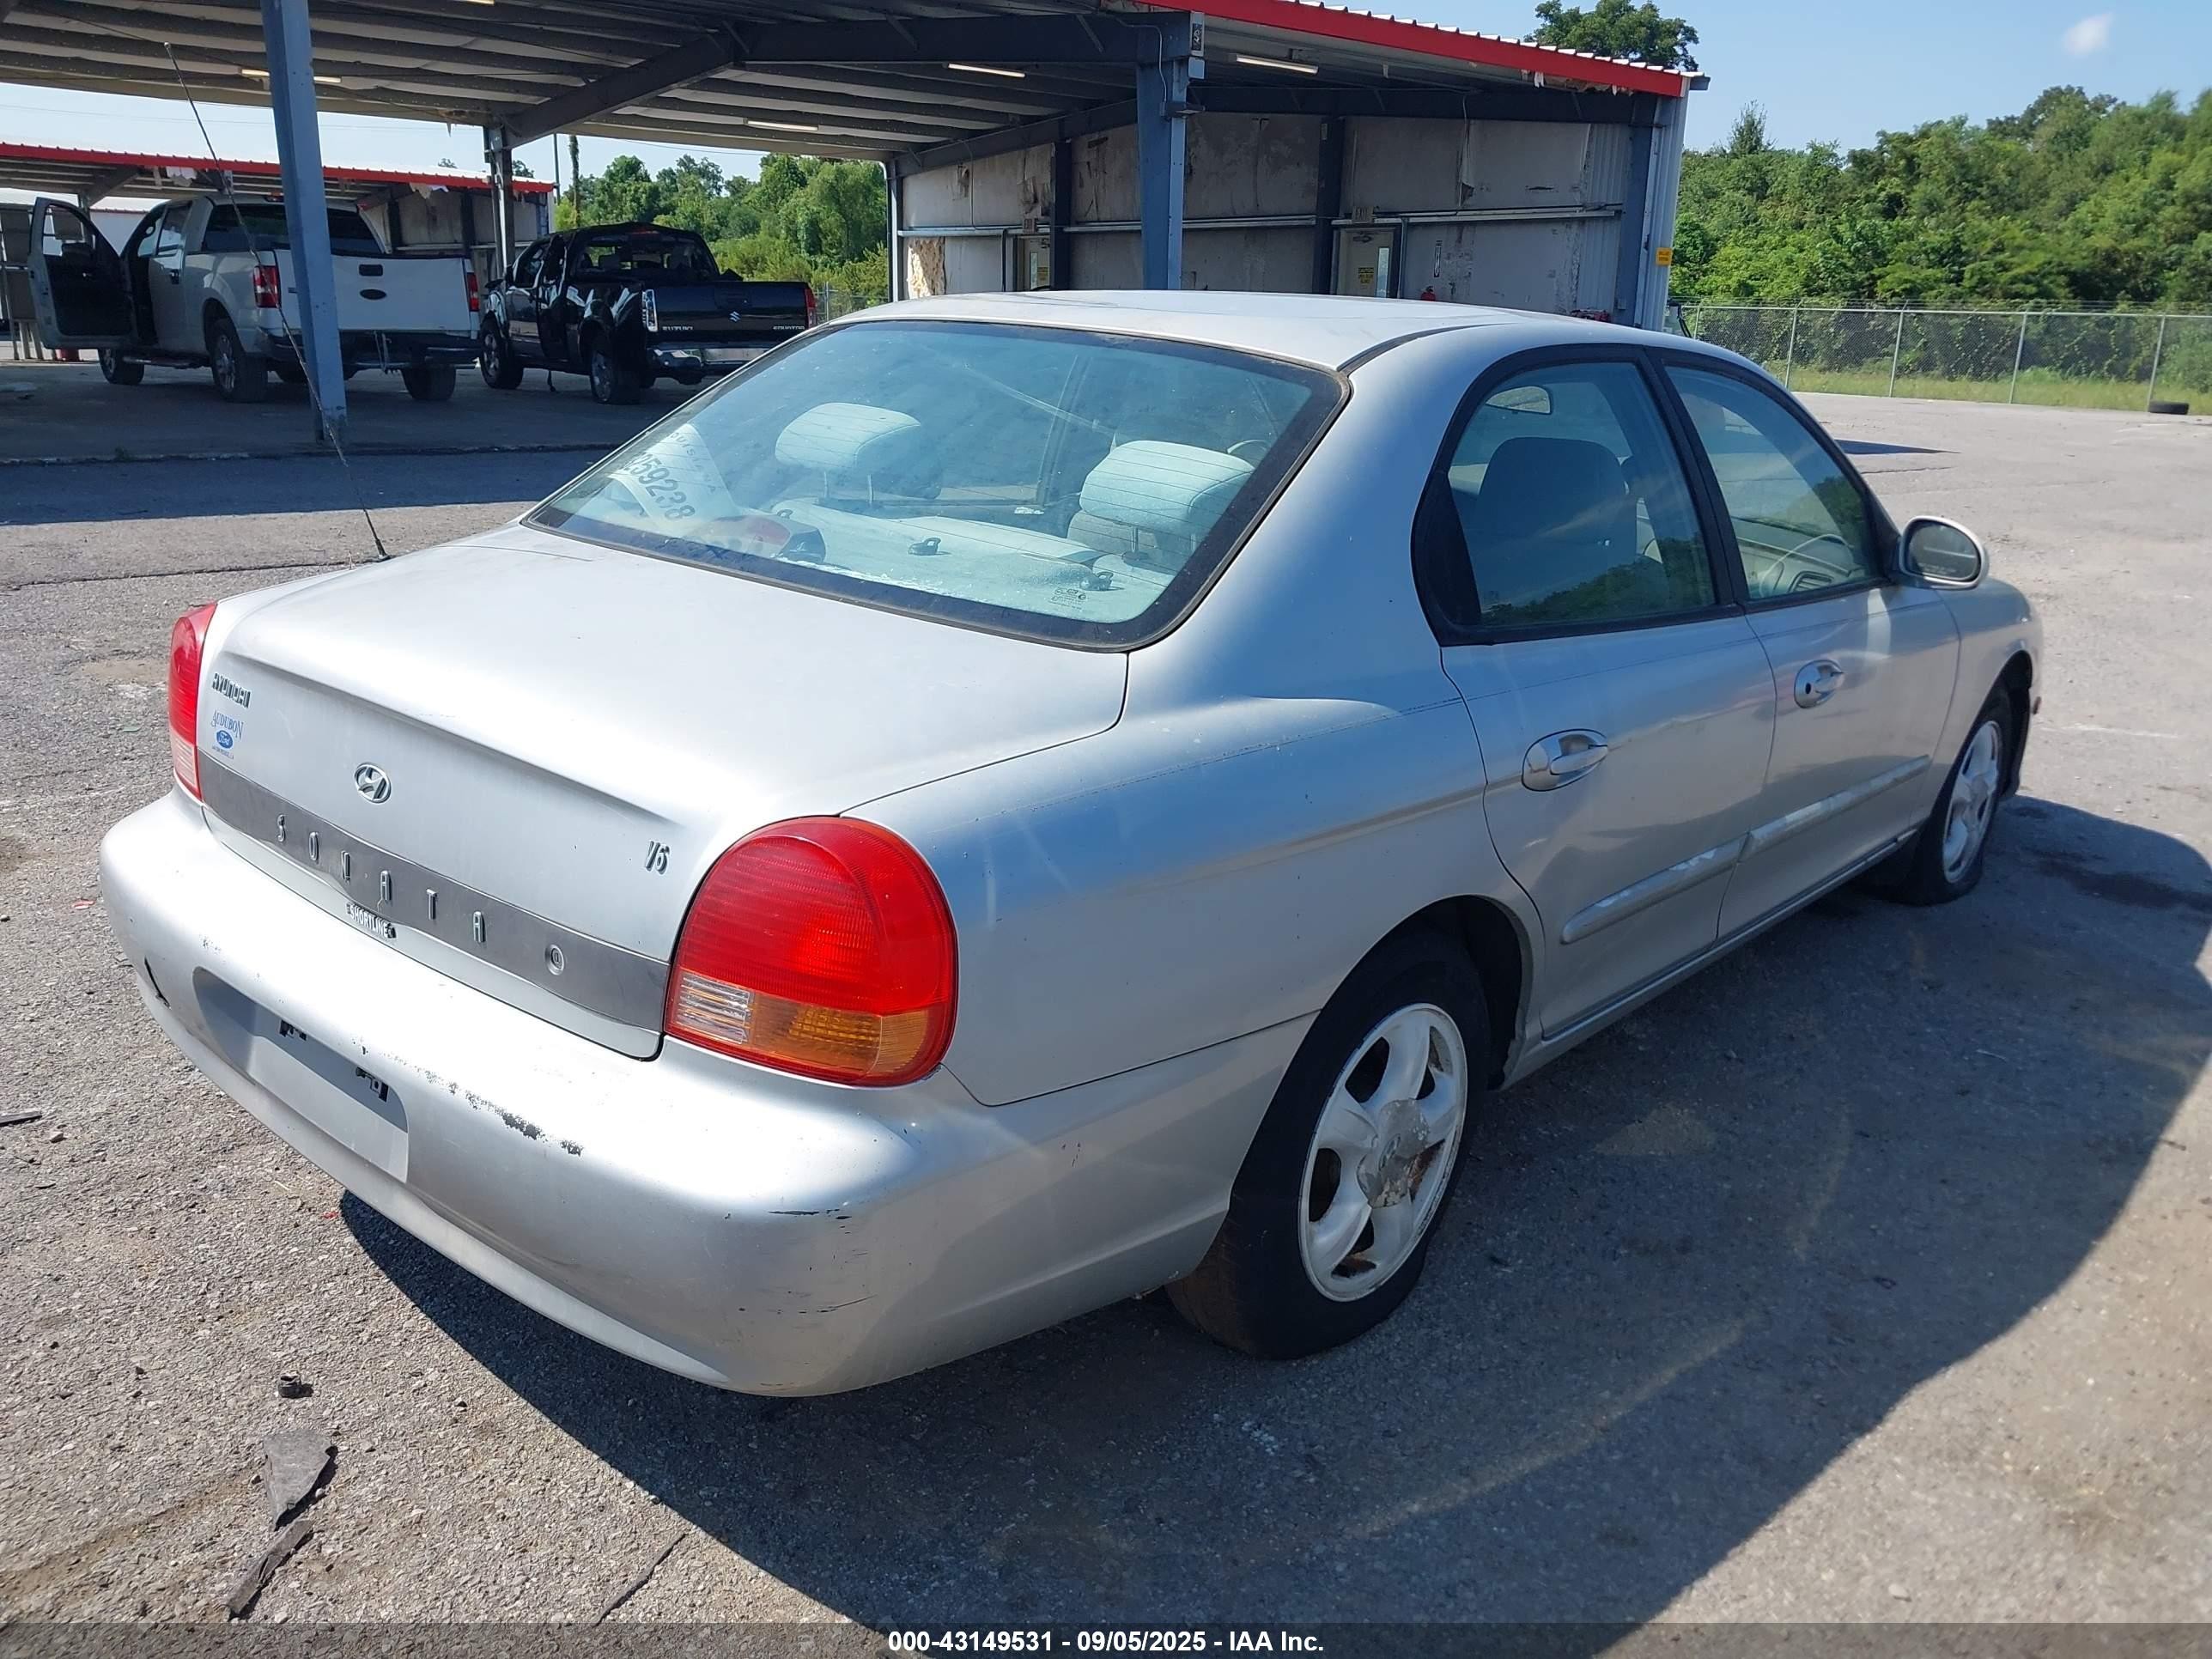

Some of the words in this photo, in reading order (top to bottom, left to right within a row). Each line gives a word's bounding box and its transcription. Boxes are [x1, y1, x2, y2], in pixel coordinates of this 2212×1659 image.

[210, 708, 244, 740] AUDUBON
[646, 840, 670, 875] V6
[276, 814, 487, 944] SONATA
[349, 903, 390, 937] SHORTLINE
